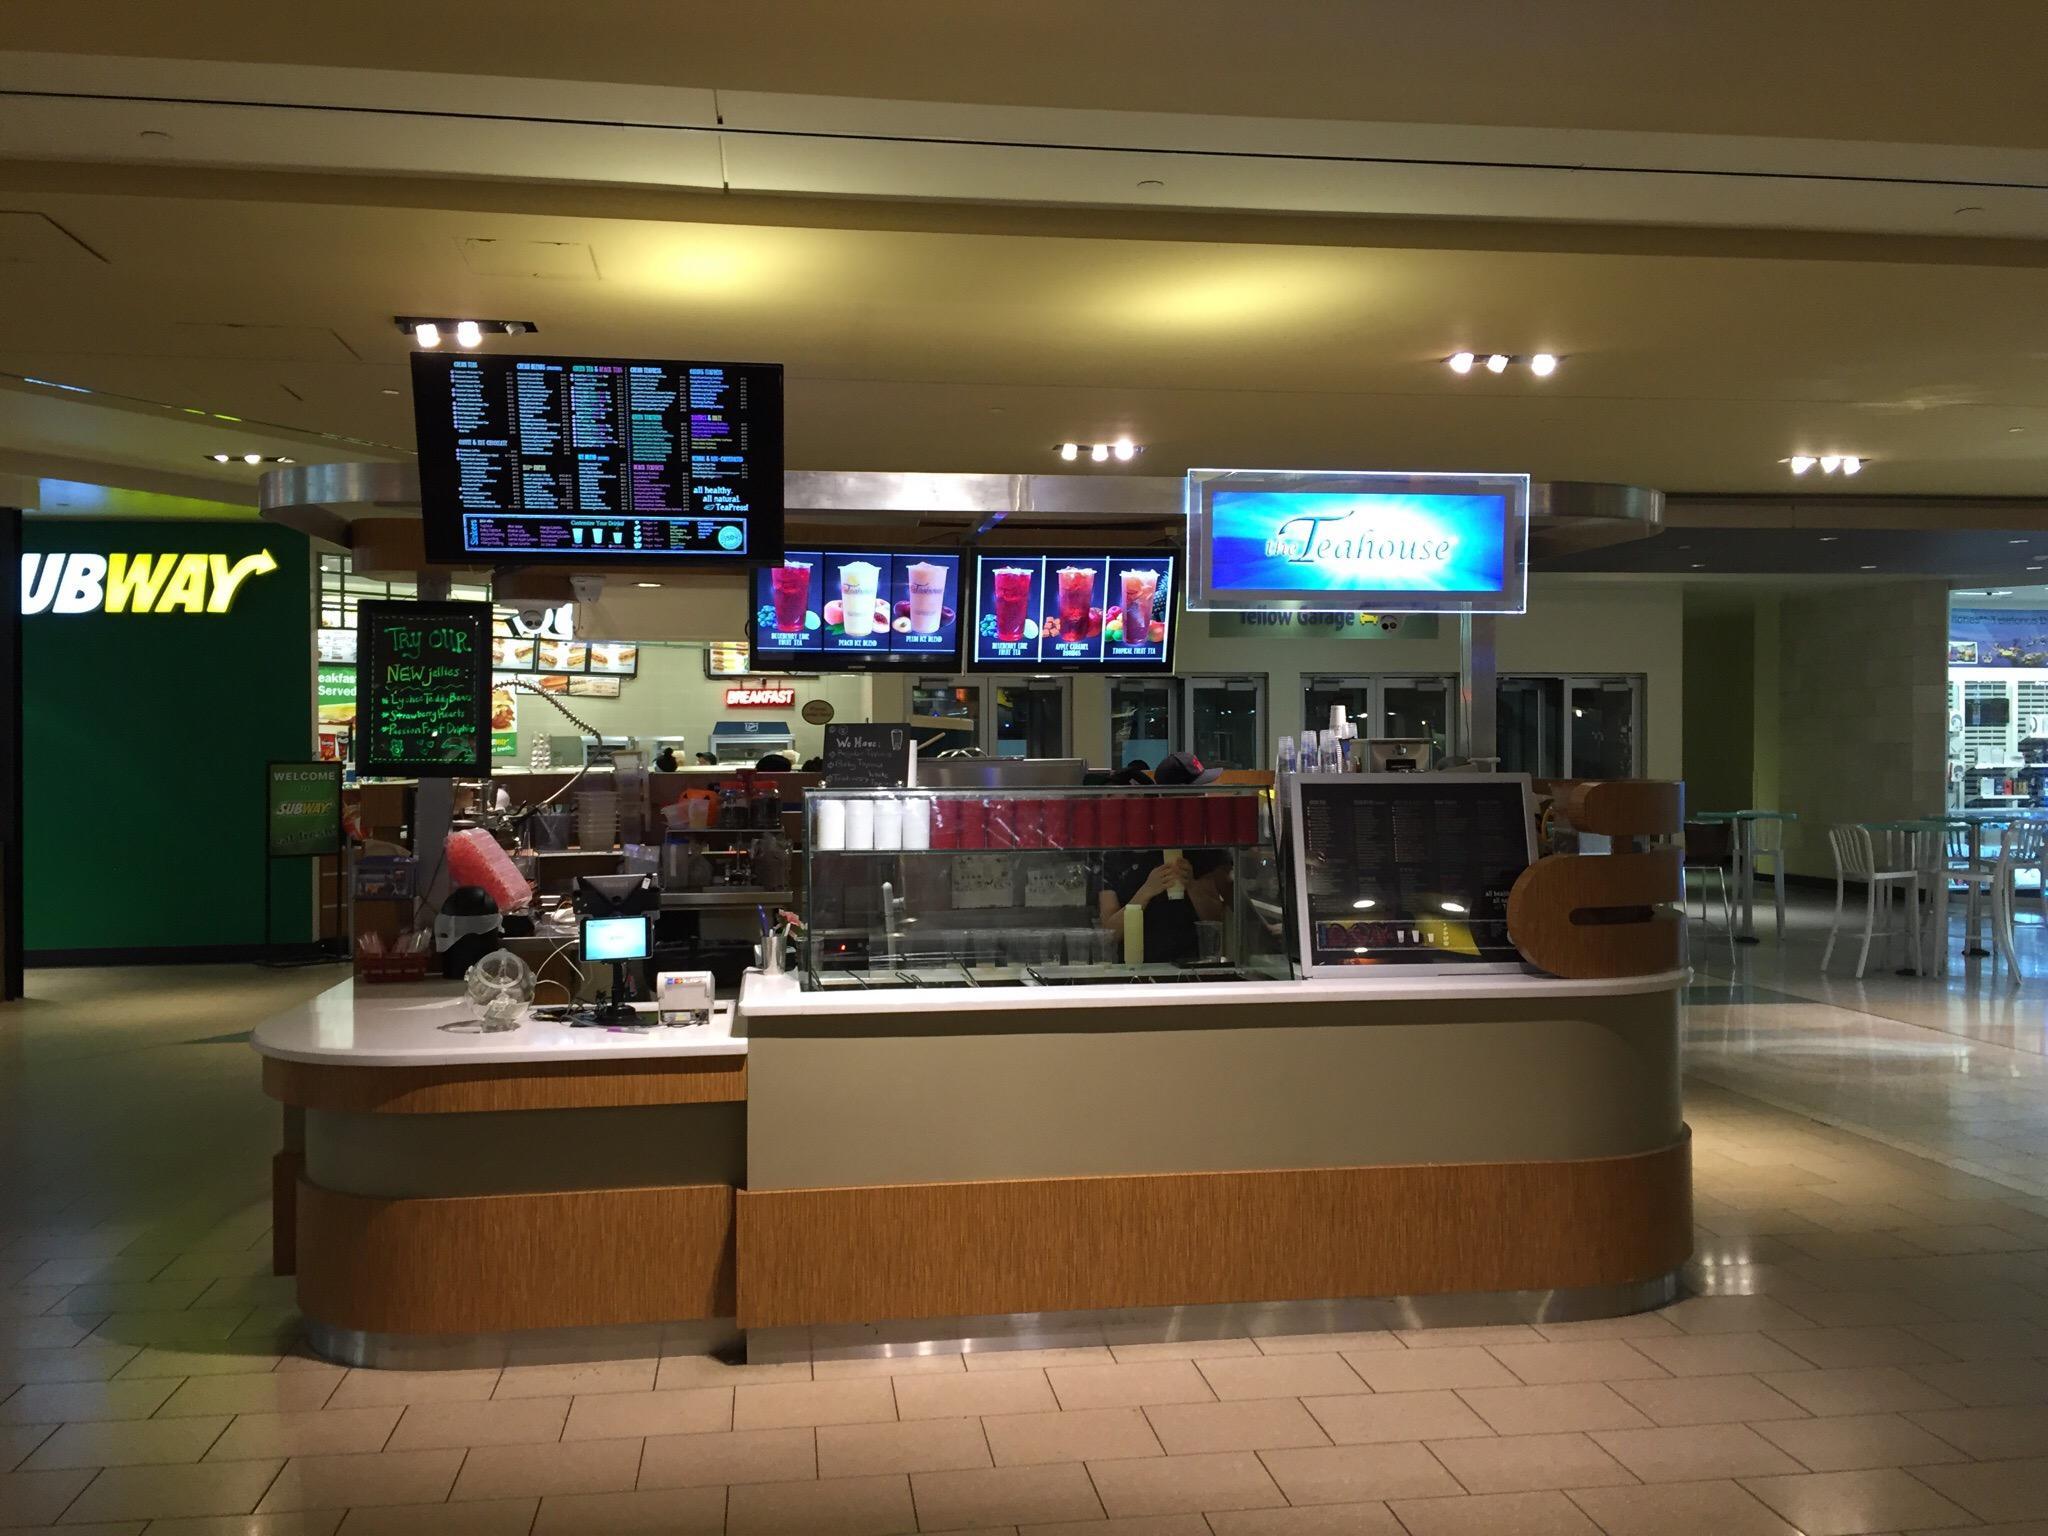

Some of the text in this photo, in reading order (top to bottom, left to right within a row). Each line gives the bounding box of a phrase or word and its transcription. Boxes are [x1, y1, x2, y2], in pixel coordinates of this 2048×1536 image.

[693, 486, 733, 496] all healthy.
[703, 495, 712, 503] all
[1278, 510, 1450, 563] Teahouse
[386, 663, 425, 684] NEW
[318, 685, 357, 697] Served
[727, 690, 794, 705] BREAKFAST
[836, 736, 851, 748] We
[273, 771, 336, 781] WELCOME
[276, 801, 335, 816] SUBWAY
